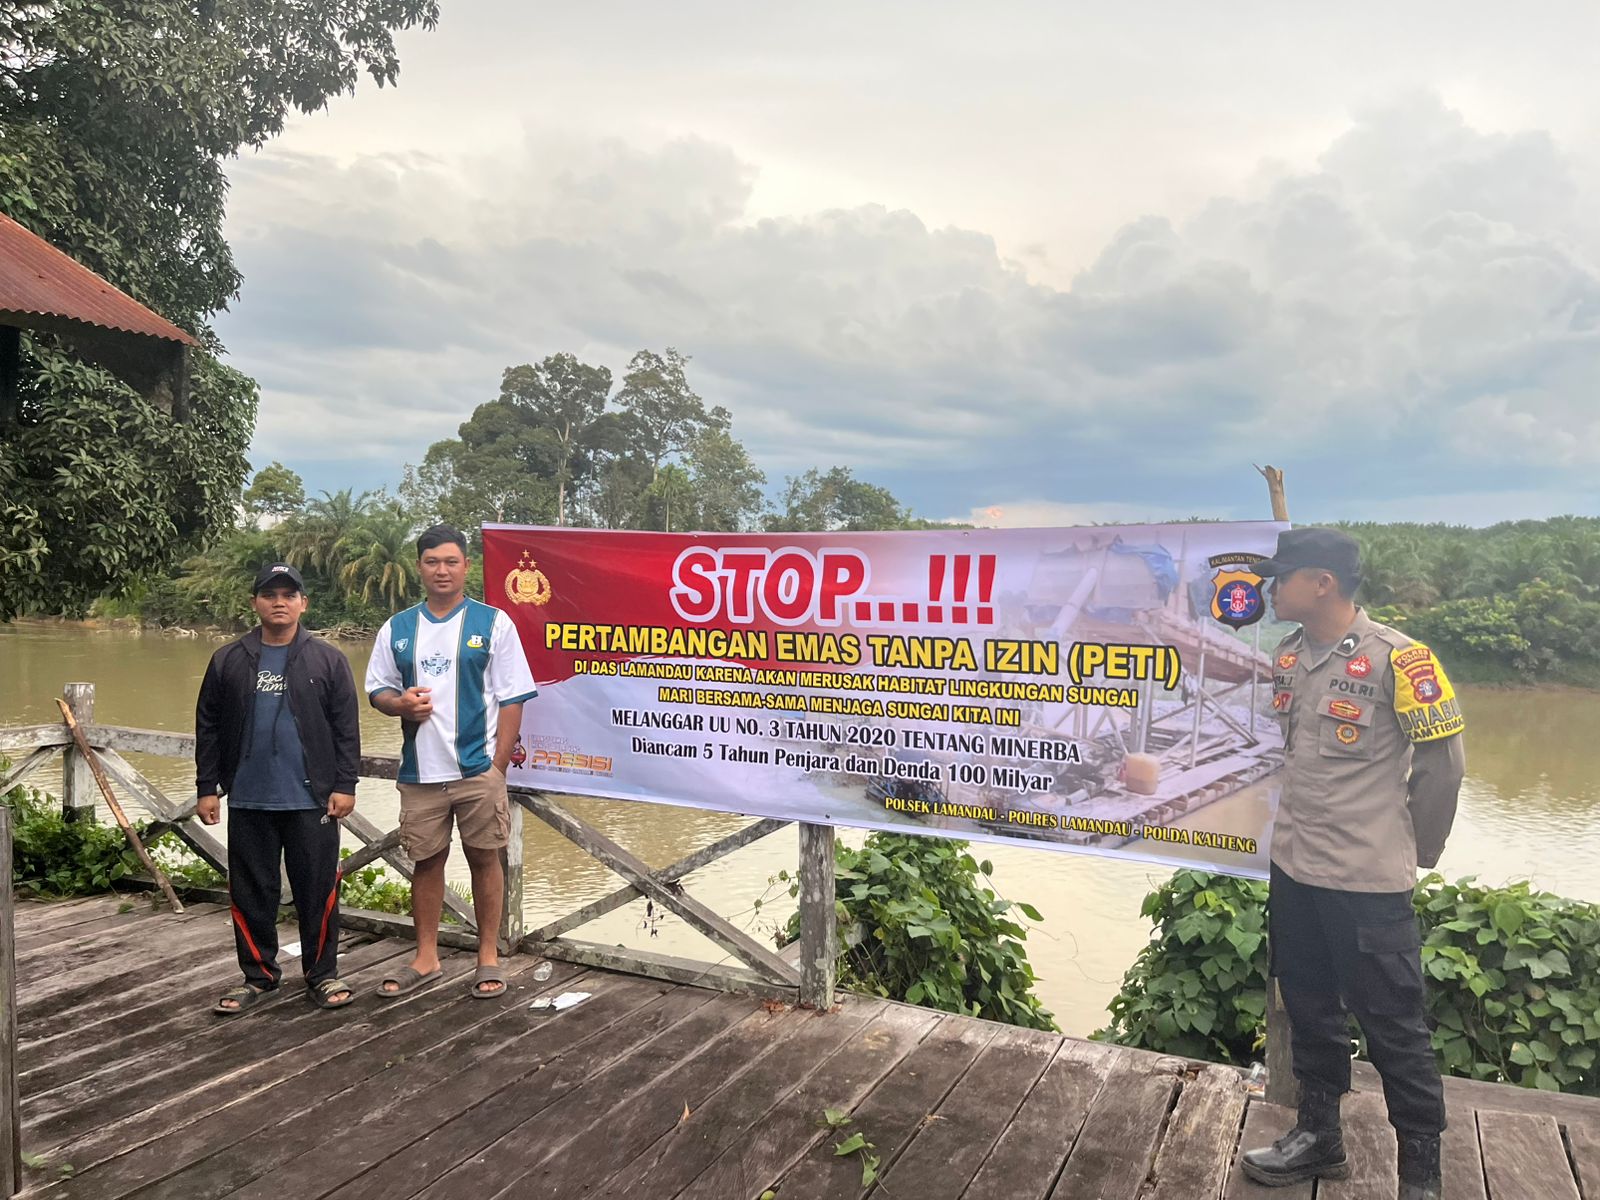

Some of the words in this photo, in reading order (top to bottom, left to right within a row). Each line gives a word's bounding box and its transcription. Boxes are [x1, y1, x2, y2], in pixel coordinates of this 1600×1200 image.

[545, 623, 767, 660] PERTAMBANGAN
[776, 632, 860, 665] EMAS
[868, 636, 977, 670] TANPA
[984, 640, 1059, 675] IZIN
[1068, 641, 1181, 690] (PETI)
[574, 659, 589, 674] DI
[590, 661, 618, 677] DAS
[620, 662, 692, 681] LAMANDAU
[695, 666, 753, 684] KARENA
[755, 669, 797, 687] AKAN
[800, 671, 873, 691] MERUSAK
[877, 676, 945, 695] HABITAT
[949, 680, 1064, 702] LINGKUNGAN
[1067, 687, 1138, 708] SUNGAI
[658, 687, 693, 704] MARI
[696, 689, 806, 713] BERSAMA-SAMA
[810, 697, 883, 717] MENJAGA
[886, 702, 948, 721] SUNGAI
[952, 707, 992, 724] KITA
[996, 709, 1021, 726] INI
[1329, 679, 1374, 697] POLRI
[532, 749, 613, 772] PRESISI
[612, 709, 704, 732] MELANGGAR
[709, 716, 730, 733] UU
[735, 718, 763, 736] NO.
[769, 720, 780, 737] 3
[786, 721, 842, 743] TAHUN
[847, 726, 896, 747] 2020
[901, 730, 984, 754] TENTANG
[991, 736, 1081, 763] MINERBA
[632, 737, 697, 758] Diancam
[702, 743, 713, 760] 5
[719, 744, 769, 765] Tahun
[775, 749, 840, 773] Penjara
[845, 755, 878, 774] dan
[883, 758, 941, 781] Denda
[948, 764, 986, 784] 100
[992, 768, 1053, 793] Milyar
[885, 797, 930, 814] POLSEK
[933, 802, 998, 821] LAMANDAU
[1008, 810, 1058, 829] POLRES
[1061, 816, 1132, 837] LAMANDAU
[1143, 826, 1190, 845] POLDA
[1193, 831, 1257, 854] KALTENG
